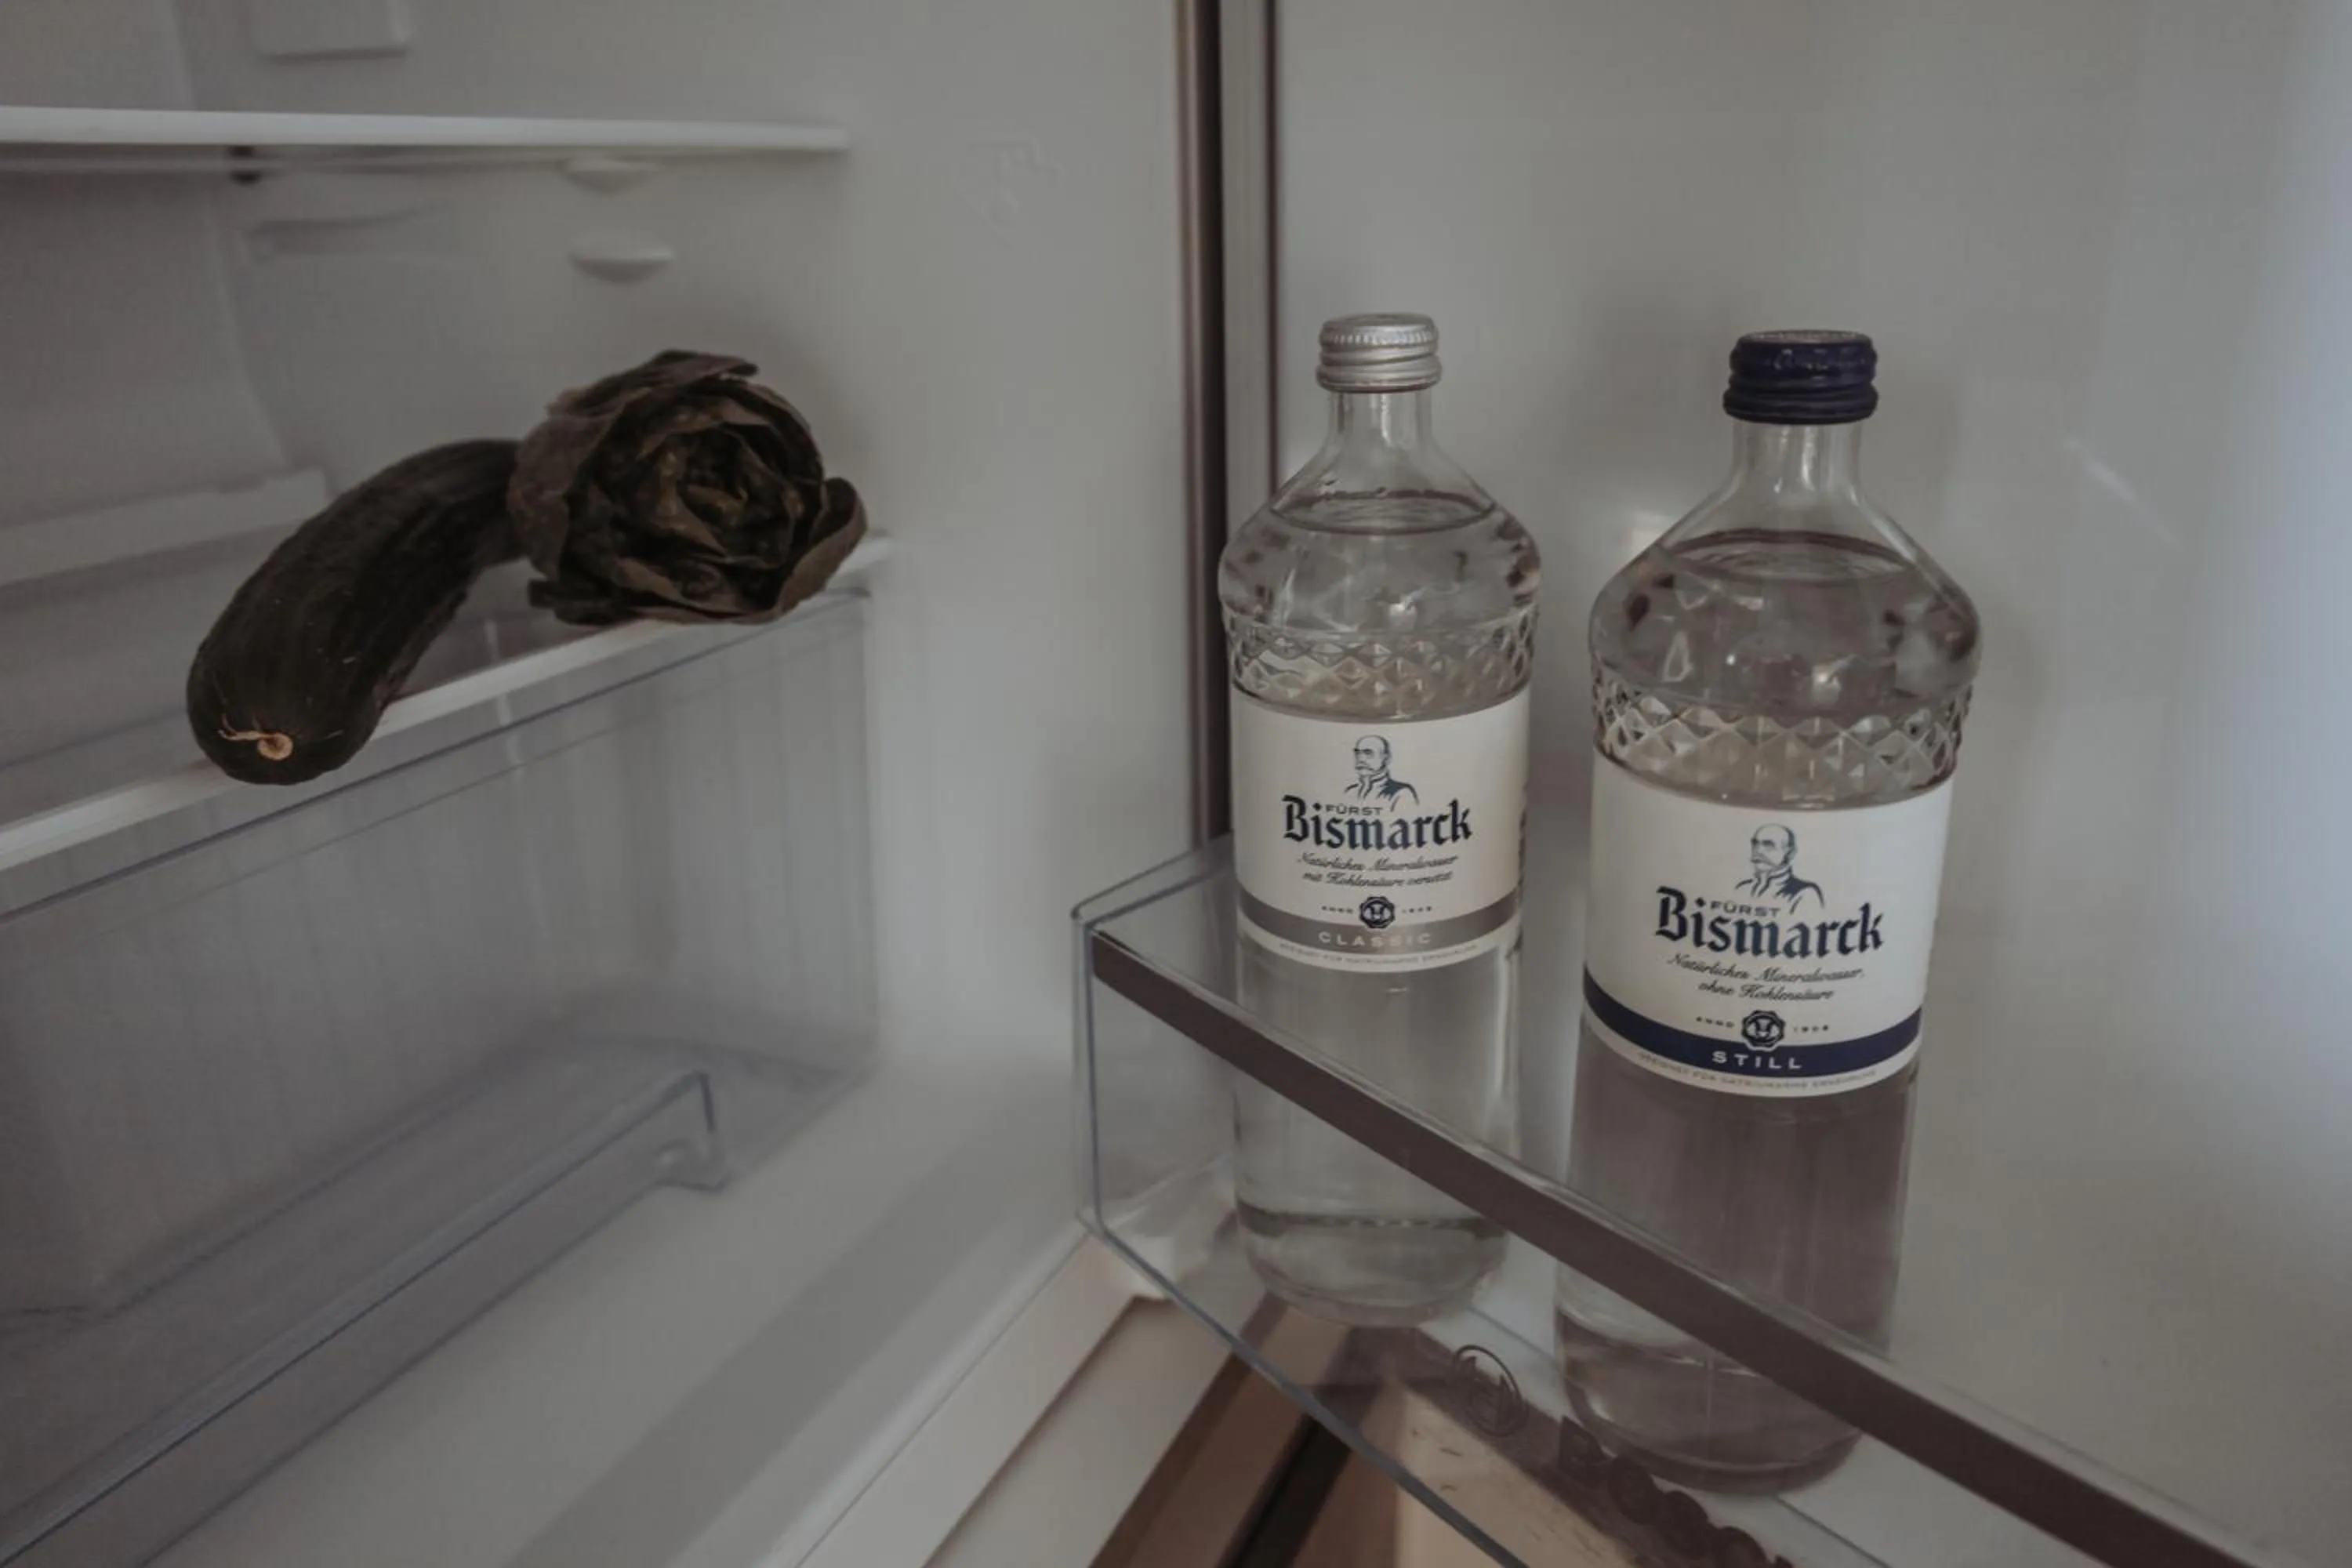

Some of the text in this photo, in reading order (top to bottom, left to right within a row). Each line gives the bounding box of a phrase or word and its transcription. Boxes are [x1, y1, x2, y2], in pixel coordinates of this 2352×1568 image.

[1325, 803, 1383, 816] FÜRST
[1282, 794, 1472, 851] Bismarck
[1709, 900, 1781, 917] FÜRST
[1654, 885, 1884, 960] Bismarck
[1318, 931, 1431, 947] CLASSIC
[1712, 1051, 1802, 1069] STILL
